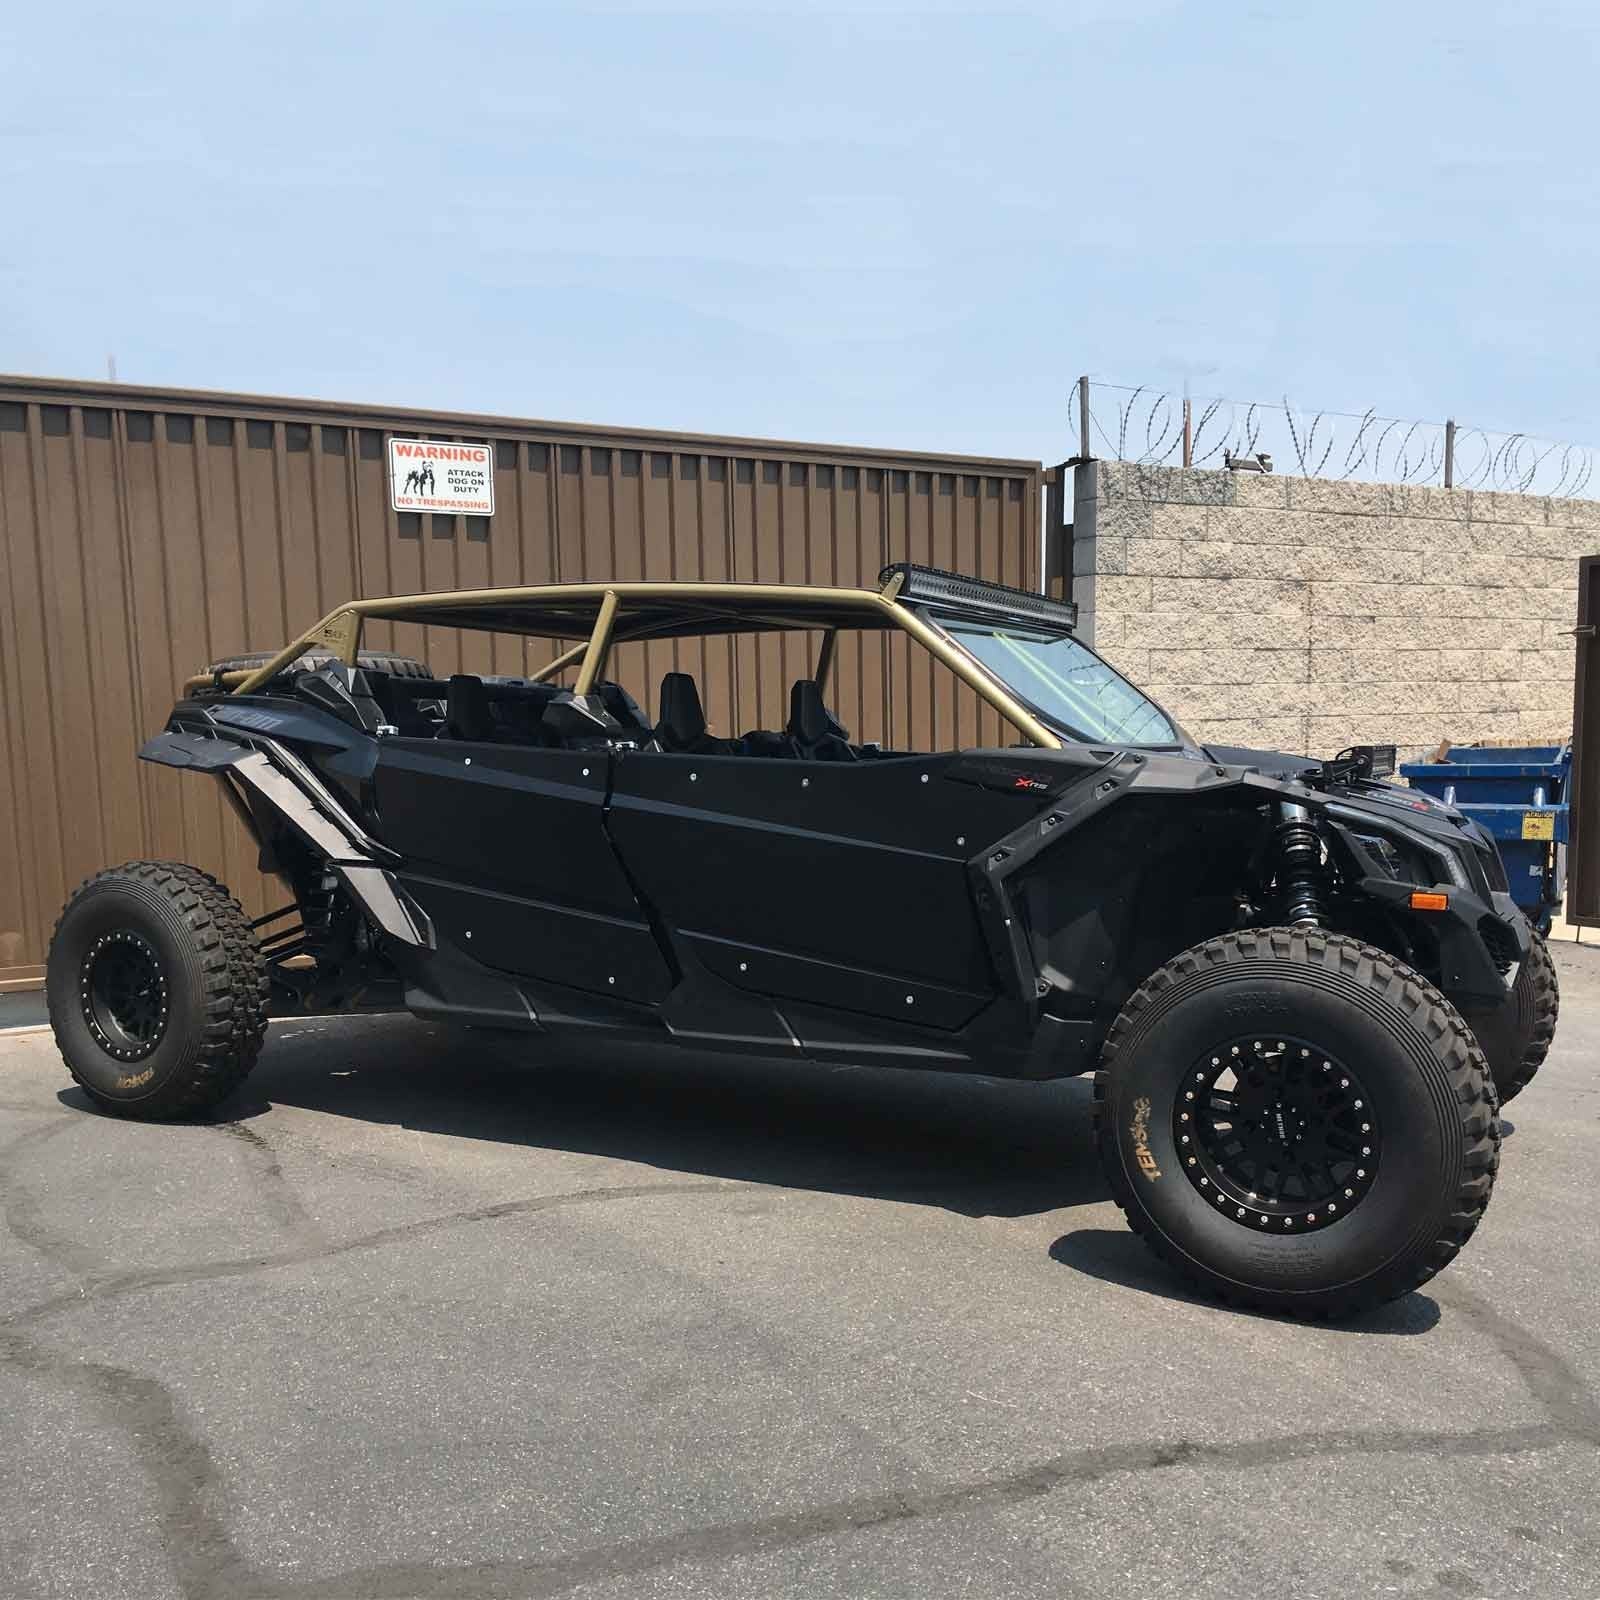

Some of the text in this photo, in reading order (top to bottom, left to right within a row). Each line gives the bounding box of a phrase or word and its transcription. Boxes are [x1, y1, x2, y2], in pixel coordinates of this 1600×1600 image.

[396, 444, 486, 462] WARNING
[448, 469, 484, 478] ATTACK
[448, 477, 484, 486] DOG ON
[397, 497, 489, 509] NO TRESPASSING
